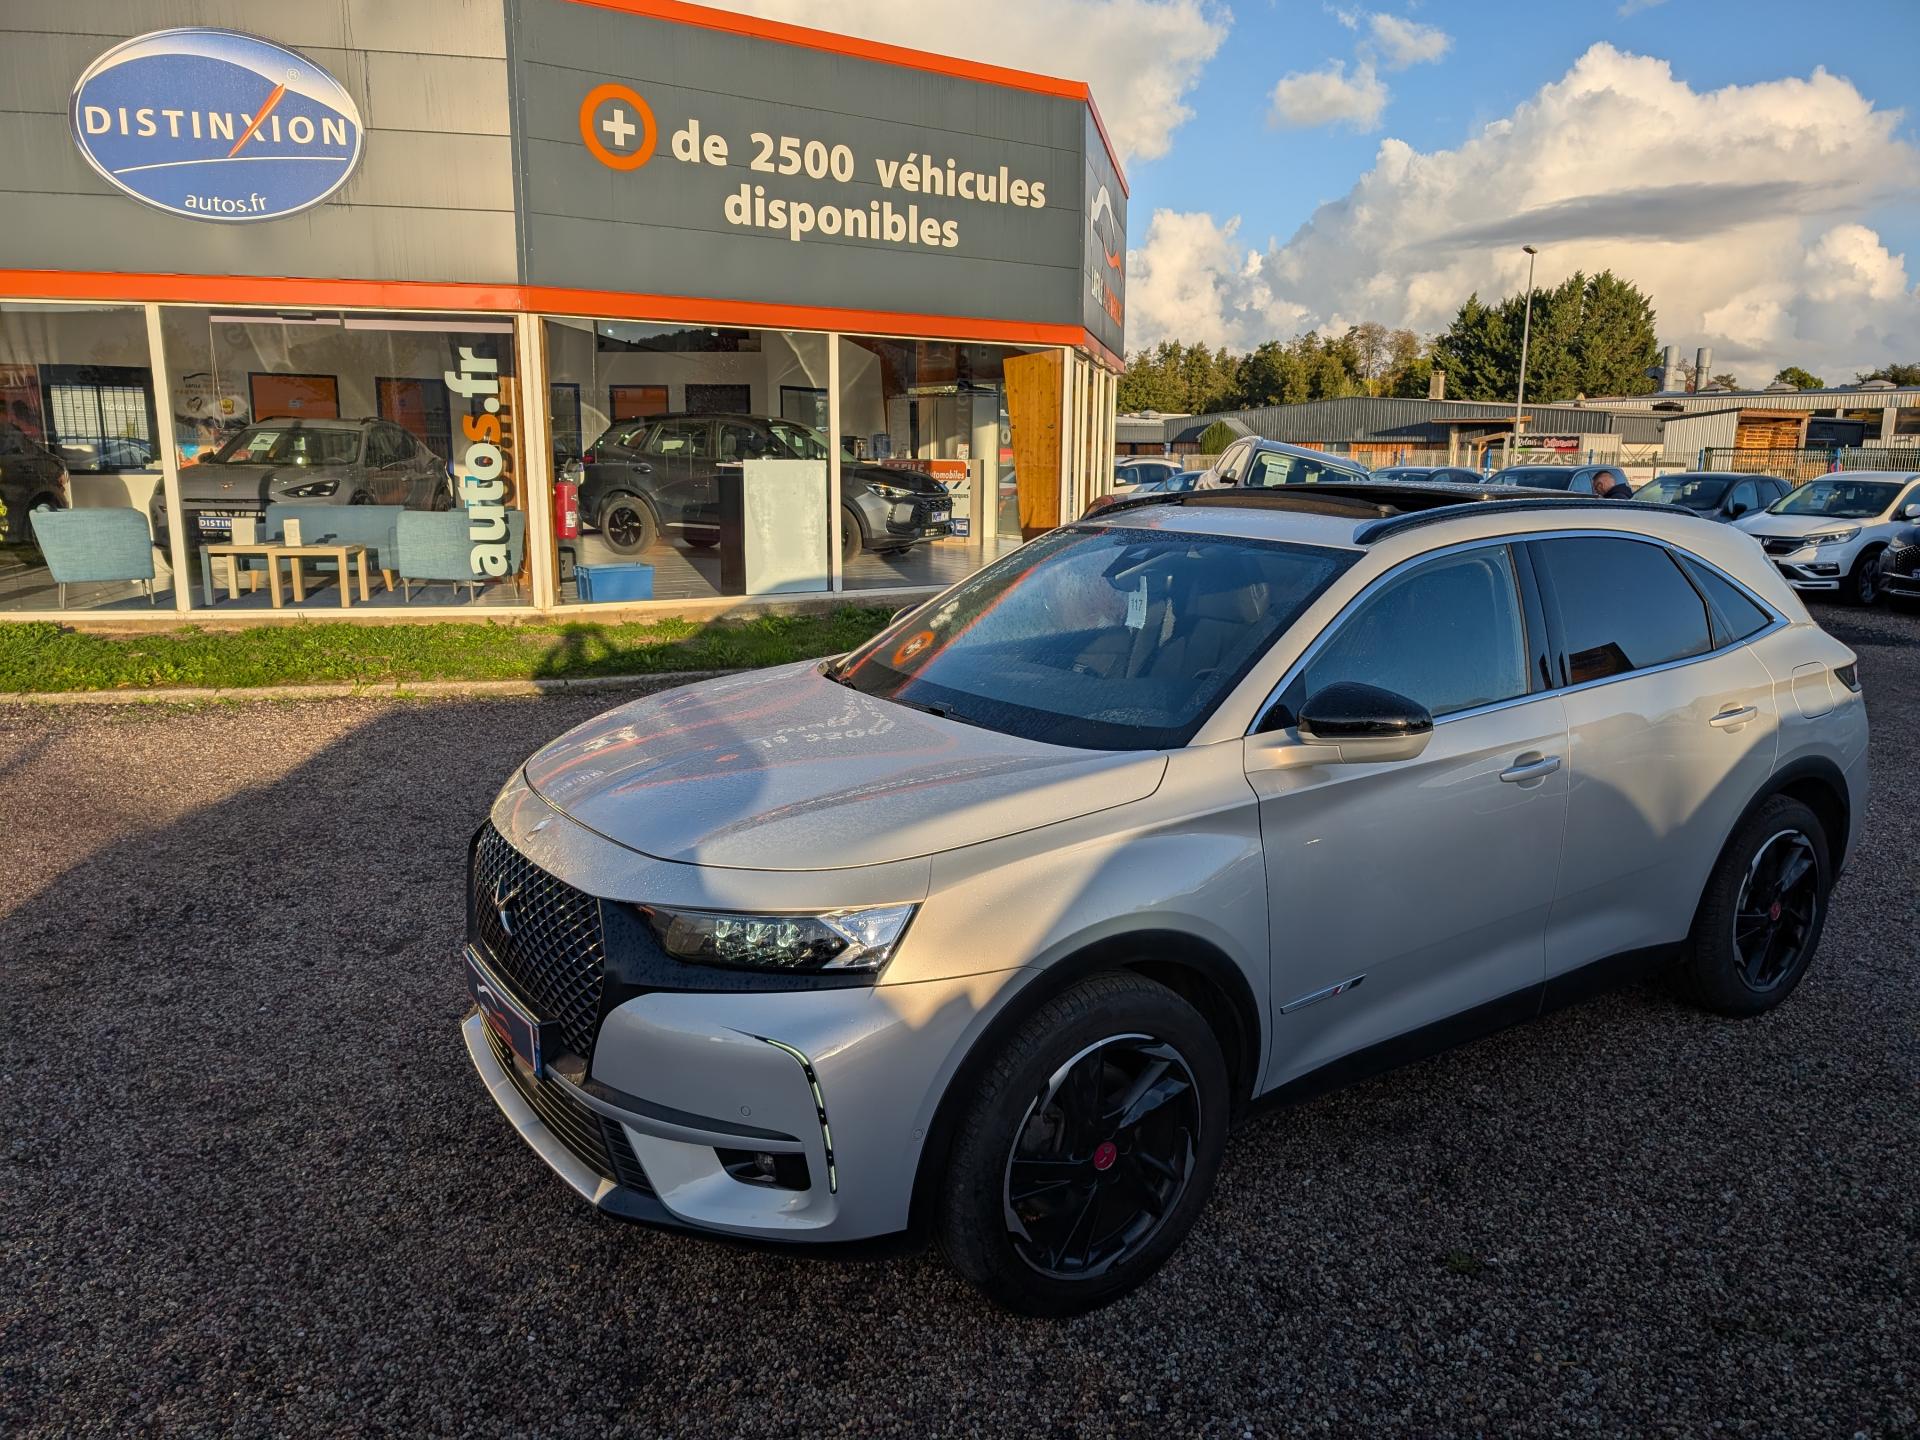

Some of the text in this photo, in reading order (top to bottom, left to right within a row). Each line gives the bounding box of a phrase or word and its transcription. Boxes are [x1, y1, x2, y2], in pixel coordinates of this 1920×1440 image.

[84, 104, 349, 147] DISTINXION
[671, 118, 729, 165] de
[750, 132, 855, 183] 2500
[875, 152, 1047, 209] véhicules
[184, 192, 267, 213] autos.fr
[724, 183, 959, 248] disponibles
[444, 347, 509, 578] autos.fr
[927, 470, 965, 480] utomobiles
